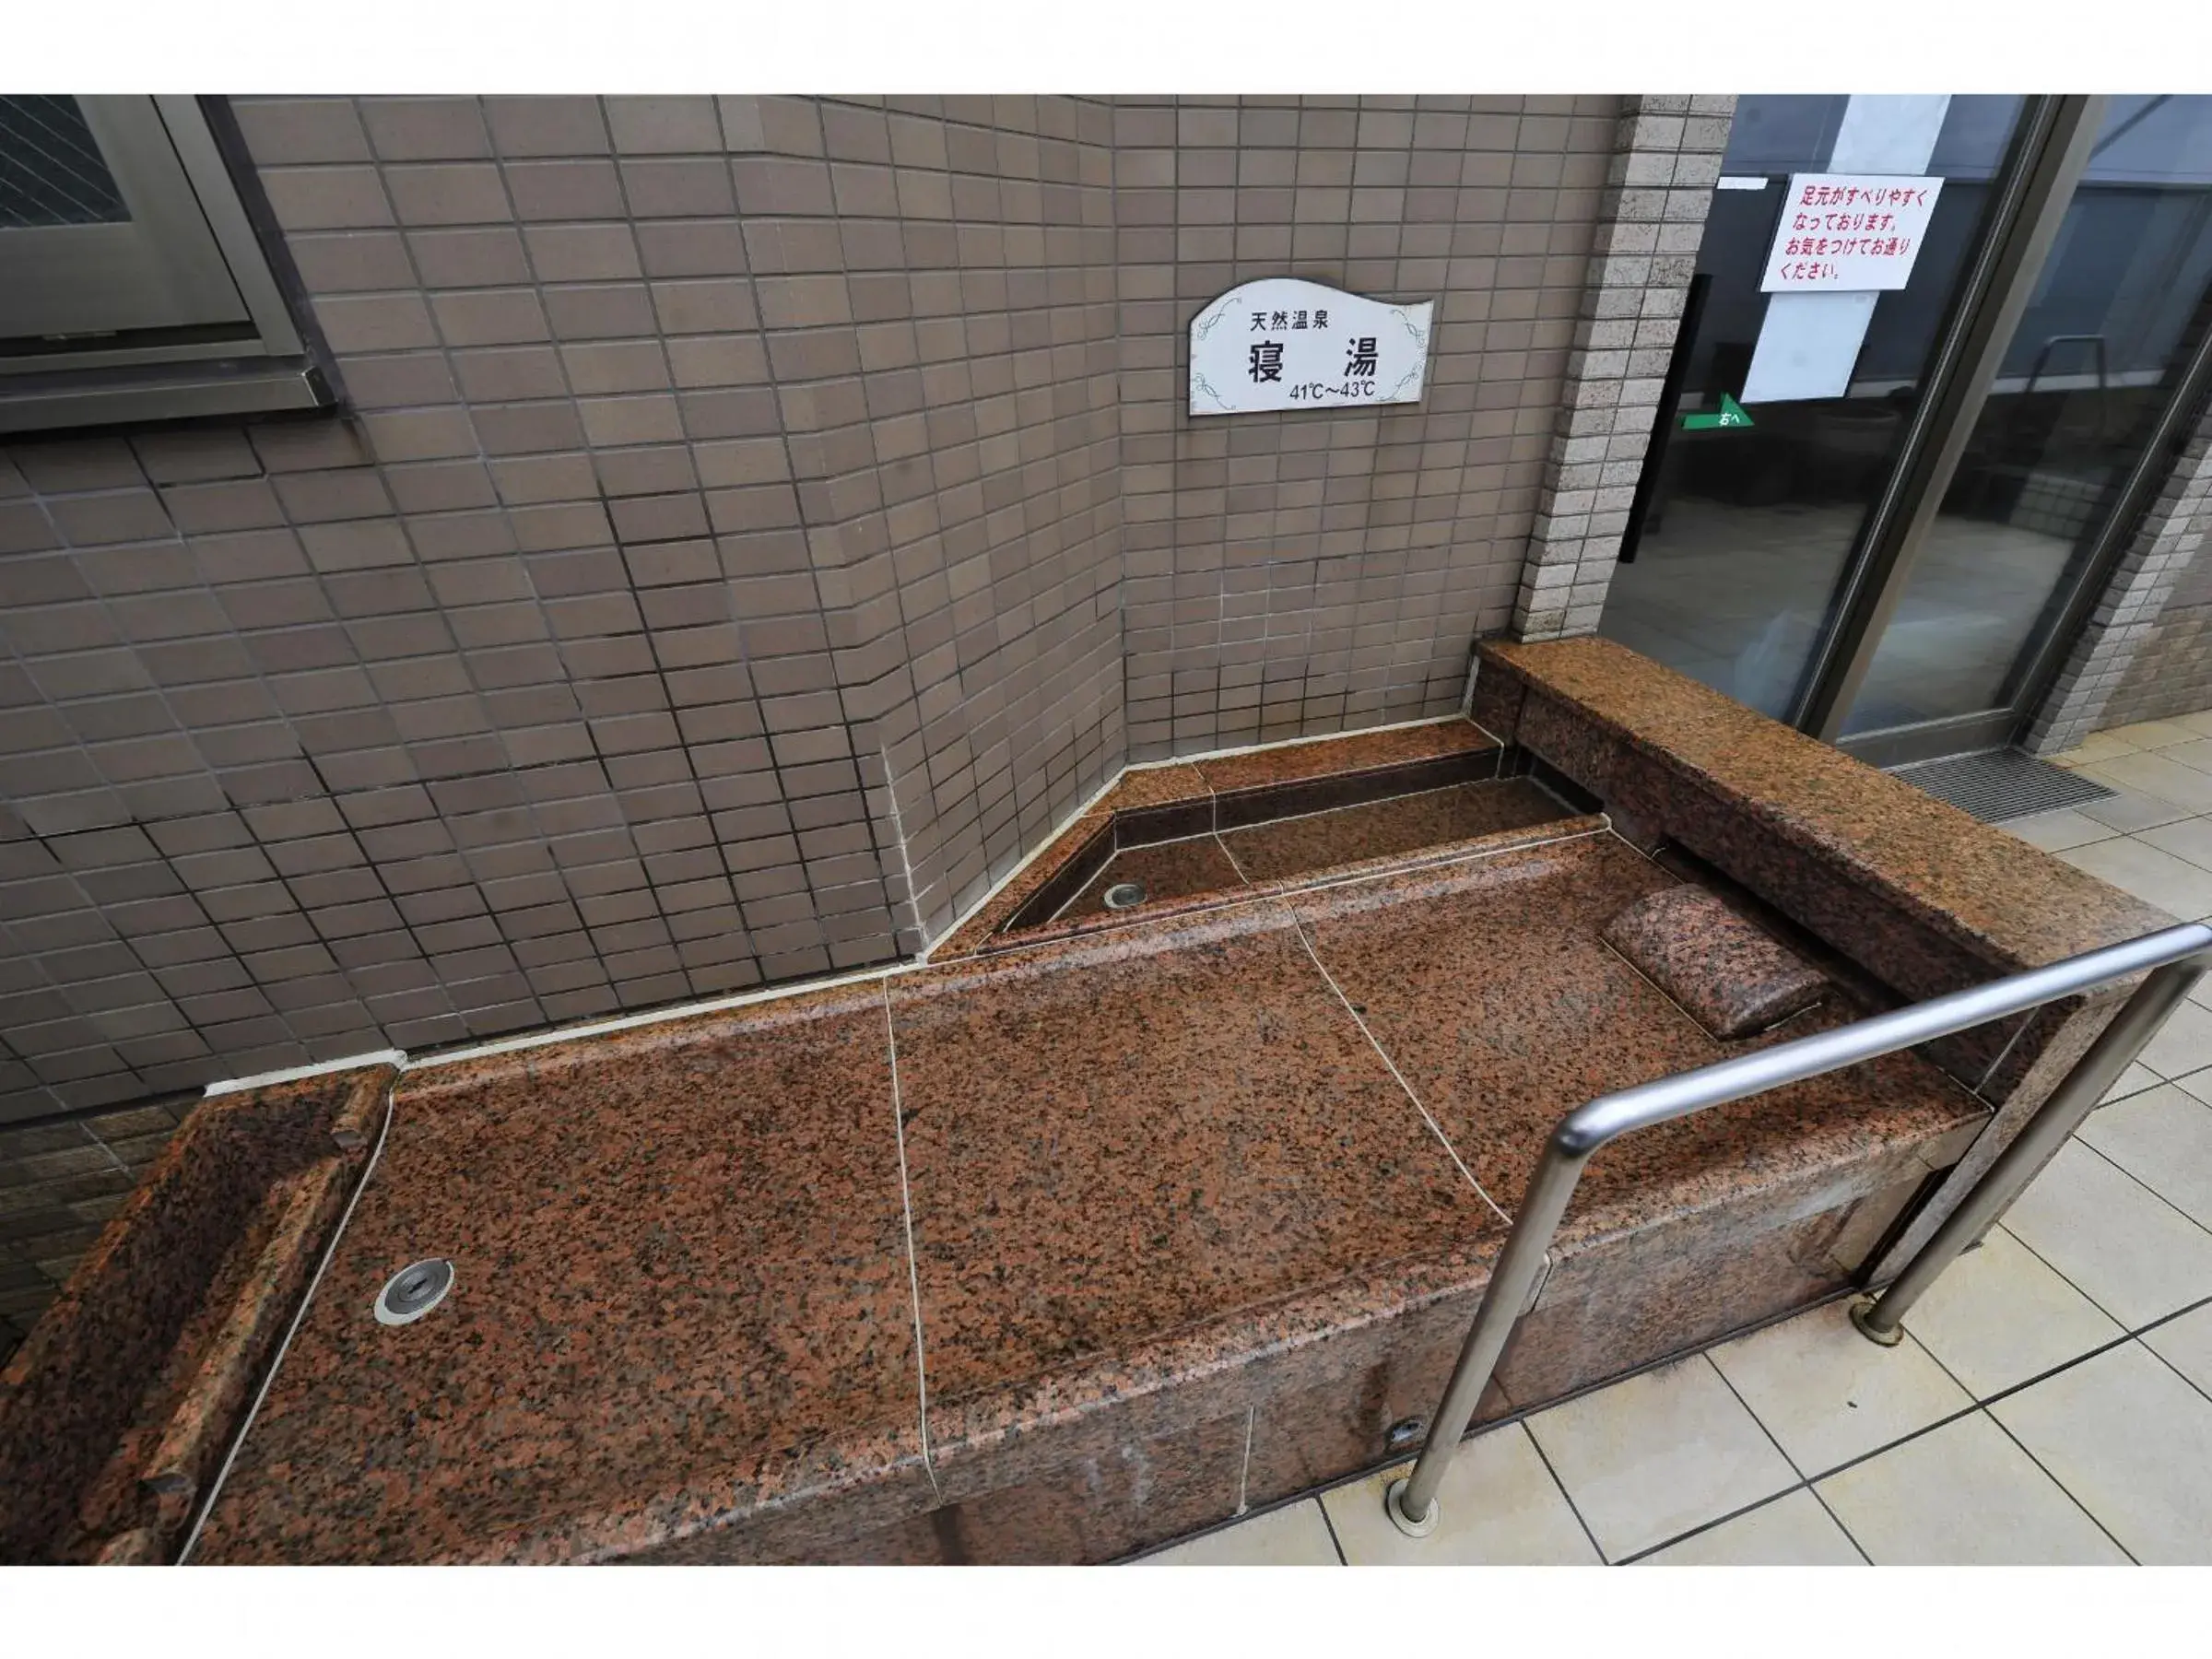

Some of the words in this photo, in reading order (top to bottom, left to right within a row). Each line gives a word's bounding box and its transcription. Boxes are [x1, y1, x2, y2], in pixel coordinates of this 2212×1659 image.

[1784, 237, 1911, 255] お気をつけてお通り
[1250, 310, 1328, 331] 天然温泉
